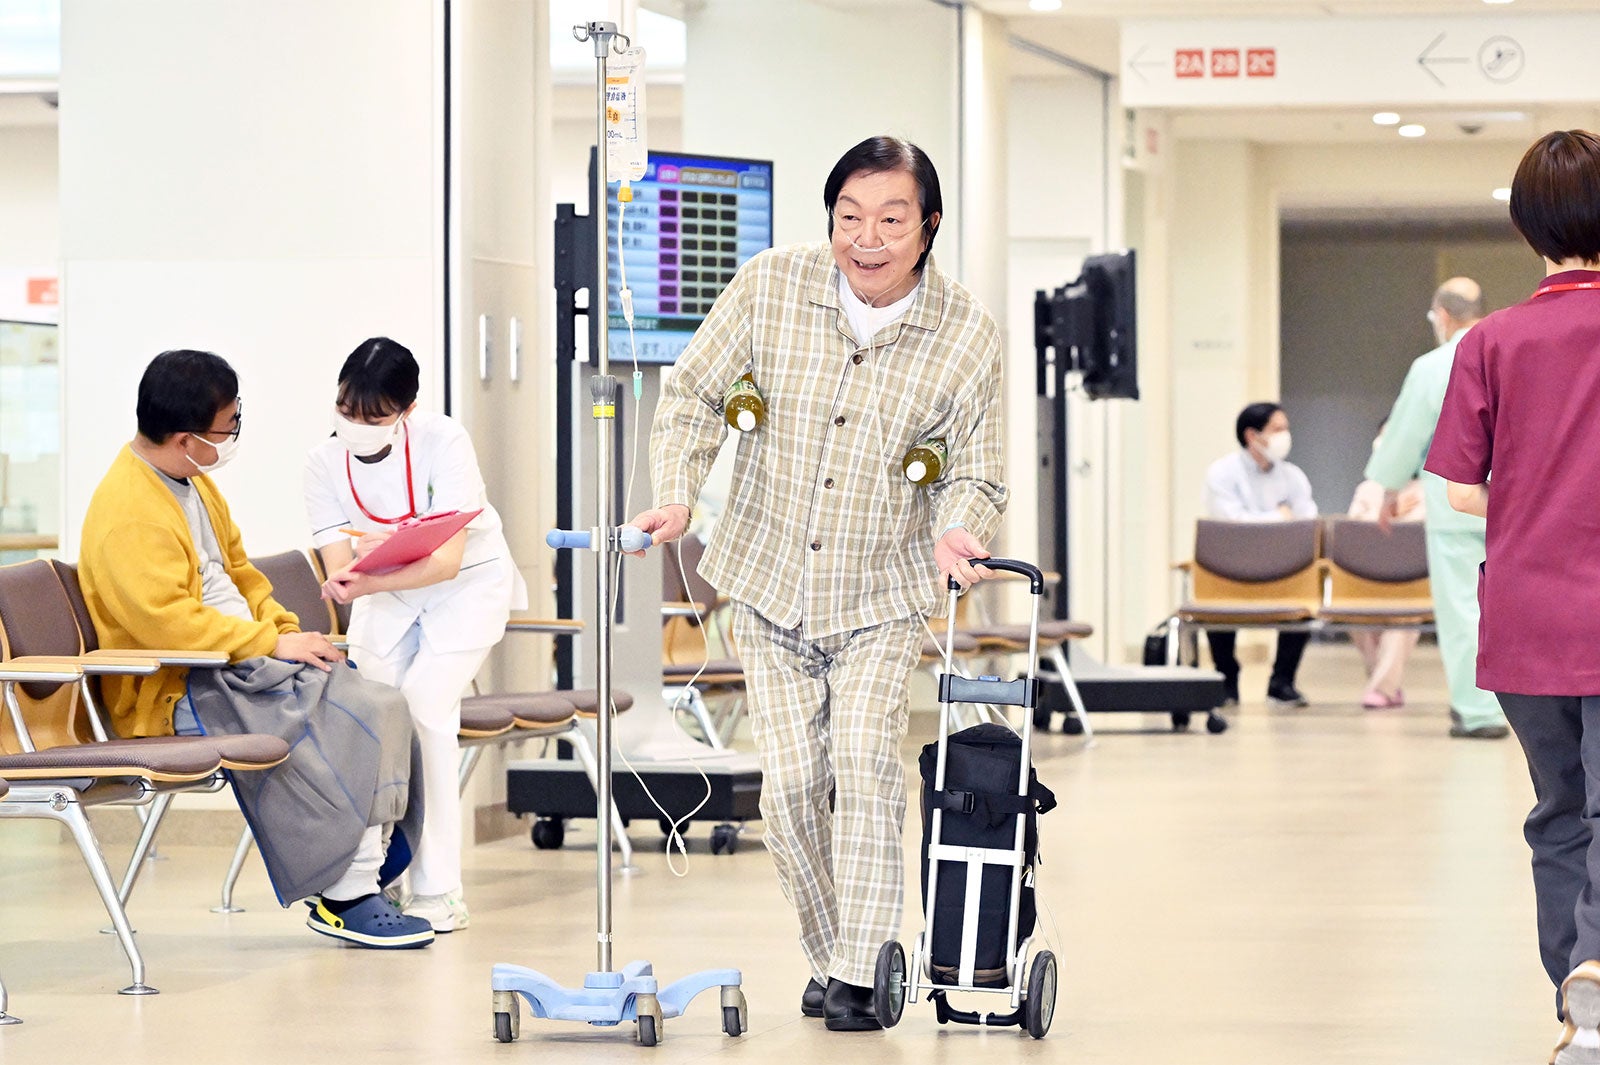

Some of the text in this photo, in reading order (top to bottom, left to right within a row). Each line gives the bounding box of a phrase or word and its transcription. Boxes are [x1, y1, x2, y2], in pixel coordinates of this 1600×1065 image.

[1176, 54, 1274, 73] 2A 2B 2C
[607, 130, 623, 138] 00mL
